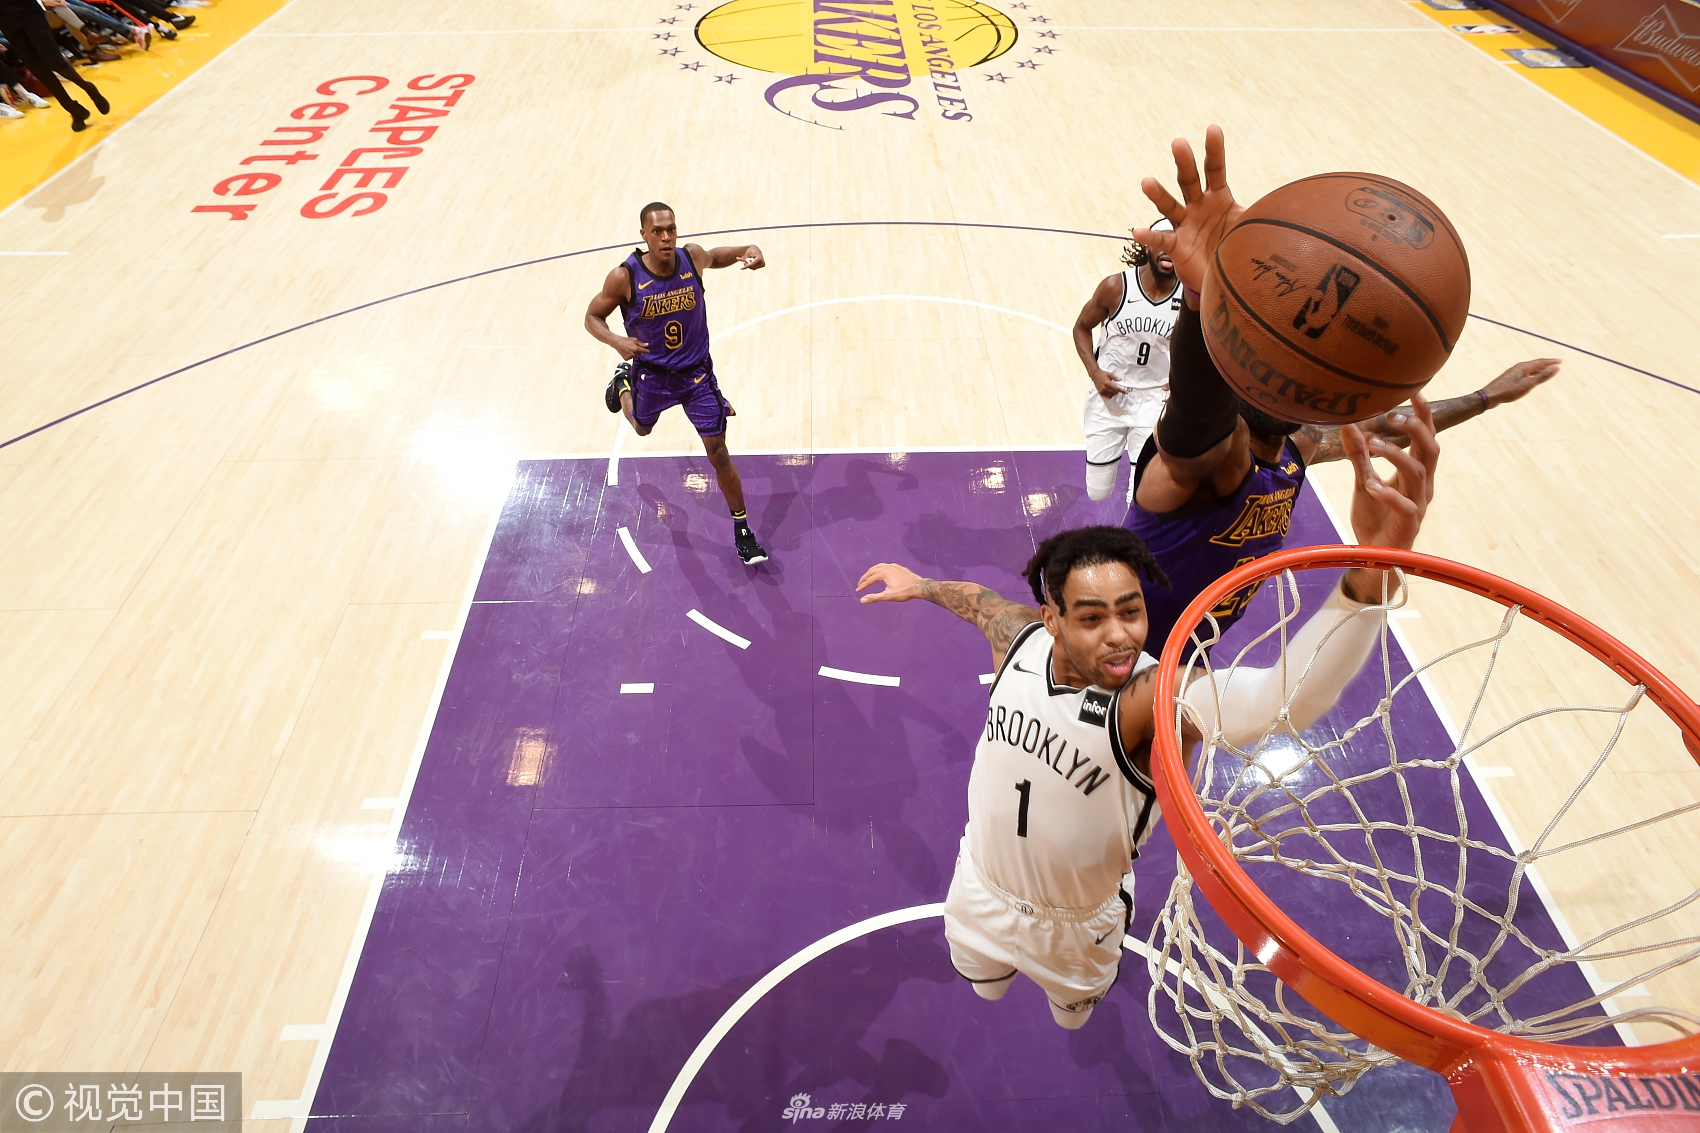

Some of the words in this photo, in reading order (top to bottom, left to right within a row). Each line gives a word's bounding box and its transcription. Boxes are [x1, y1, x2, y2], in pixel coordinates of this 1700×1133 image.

[911, 4, 942, 31] LOS
[919, 32, 973, 122] ANGELES
[190, 75, 389, 220] Center
[300, 73, 475, 219] STAPLES
[639, 292, 696, 319] LAKERS
[1116, 316, 1174, 340] BROOKLY
[664, 320, 684, 350] 9
[1136, 342, 1151, 366] 9
[1208, 294, 1372, 416] SPALDING
[1209, 495, 1293, 547] LAKERS
[1083, 698, 1107, 717] infor
[986, 705, 1110, 796] BROOKLYN
[1015, 778, 1031, 838] 1
